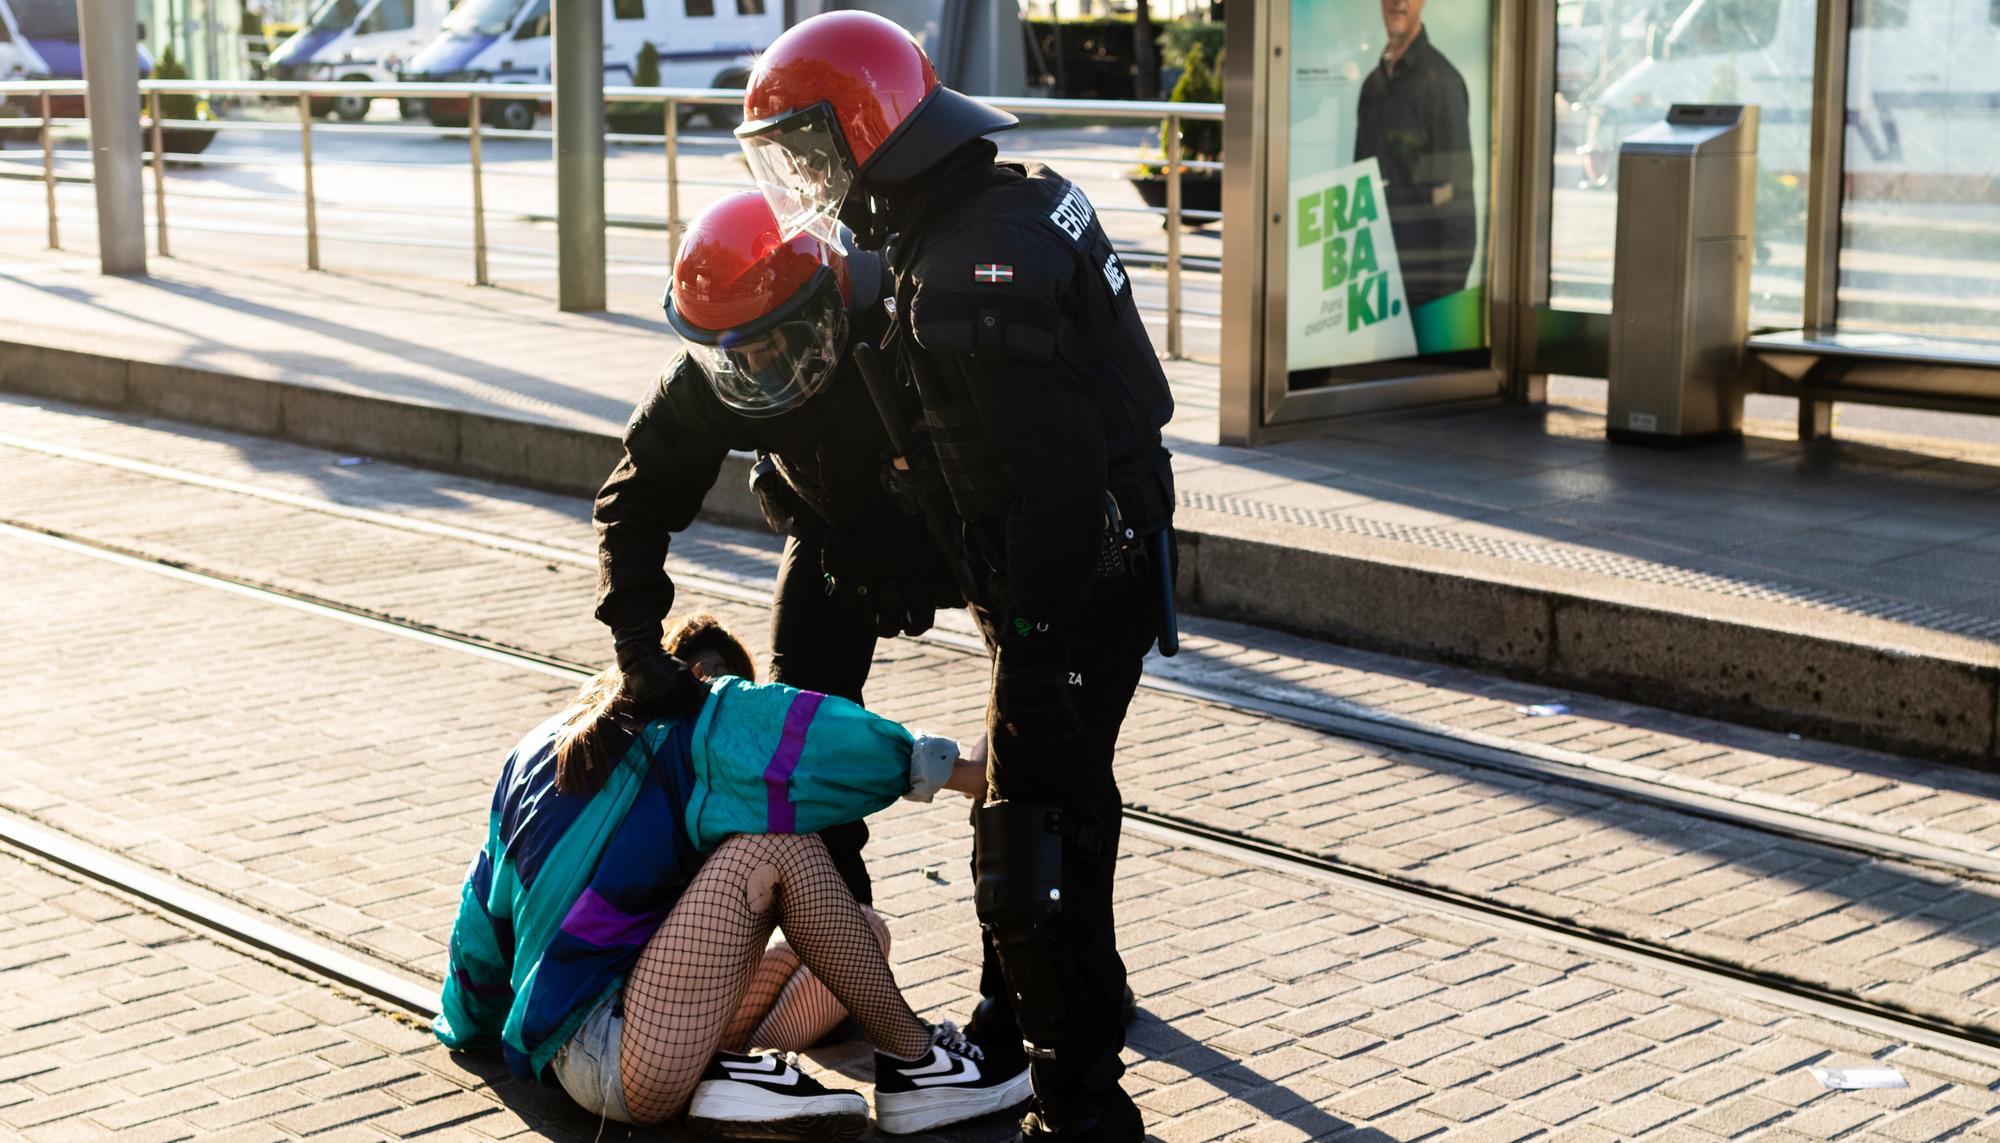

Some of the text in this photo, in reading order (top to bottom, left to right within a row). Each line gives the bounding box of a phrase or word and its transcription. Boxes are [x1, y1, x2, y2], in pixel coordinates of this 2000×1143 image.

[1296, 174, 1379, 249] ERA
[1321, 225, 1379, 292] BA
[1347, 270, 1403, 333] KI.
